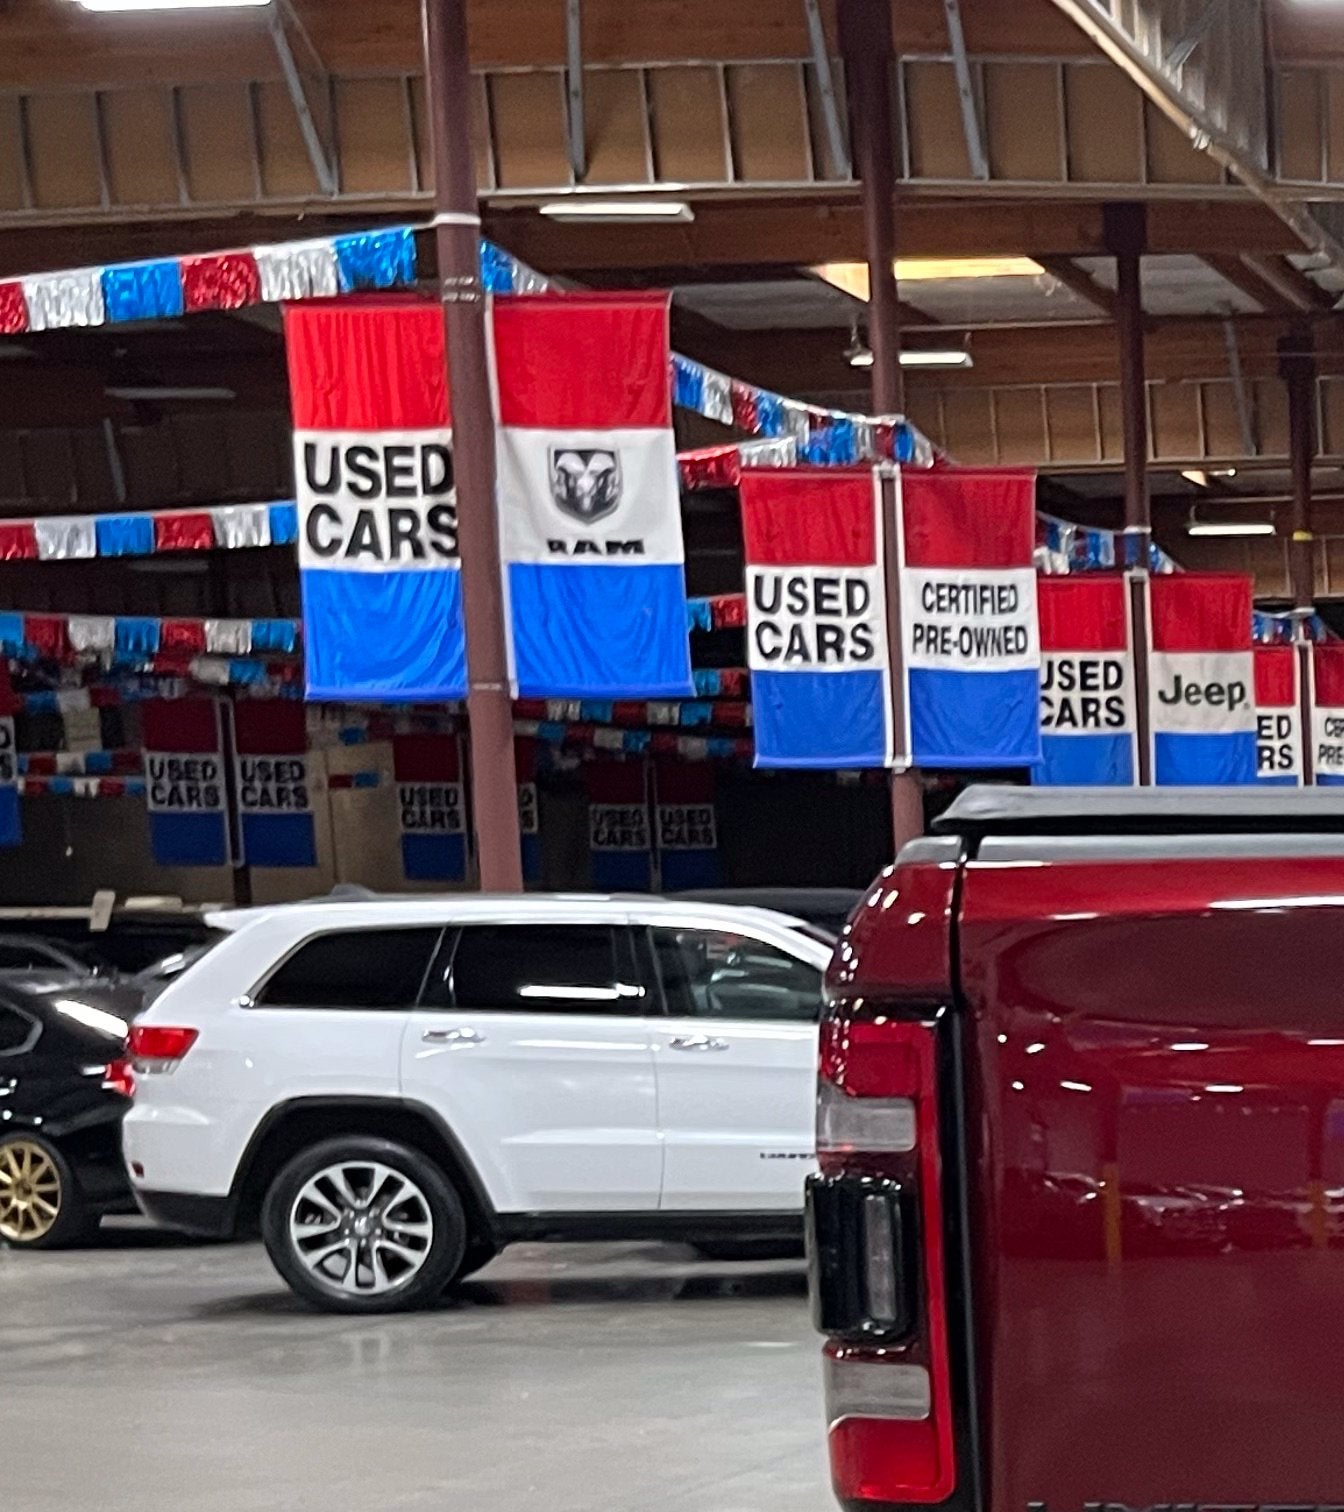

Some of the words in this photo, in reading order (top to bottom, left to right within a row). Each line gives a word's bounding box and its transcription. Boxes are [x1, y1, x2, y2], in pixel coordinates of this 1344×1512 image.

[304, 442, 455, 499] USED
[306, 503, 459, 560] CARS
[546, 539, 645, 555] RAM
[754, 575, 870, 618] USED
[922, 582, 1018, 615] CERTIFIED
[755, 621, 874, 663] CARS
[912, 623, 1028, 658] PRE-OWNED
[1041, 660, 1123, 691] USED
[1158, 675, 1246, 711] Jeep
[1041, 696, 1126, 727] CARS
[1257, 715, 1291, 740] ED
[1257, 744, 1293, 769] RS
[149, 757, 218, 782] USED
[240, 758, 305, 784] USED
[151, 784, 220, 808] CARS
[240, 785, 308, 809] CARS
[400, 787, 459, 807] USED
[401, 808, 462, 830] CARS
[659, 808, 711, 826] USED
[660, 826, 714, 847] CARS
